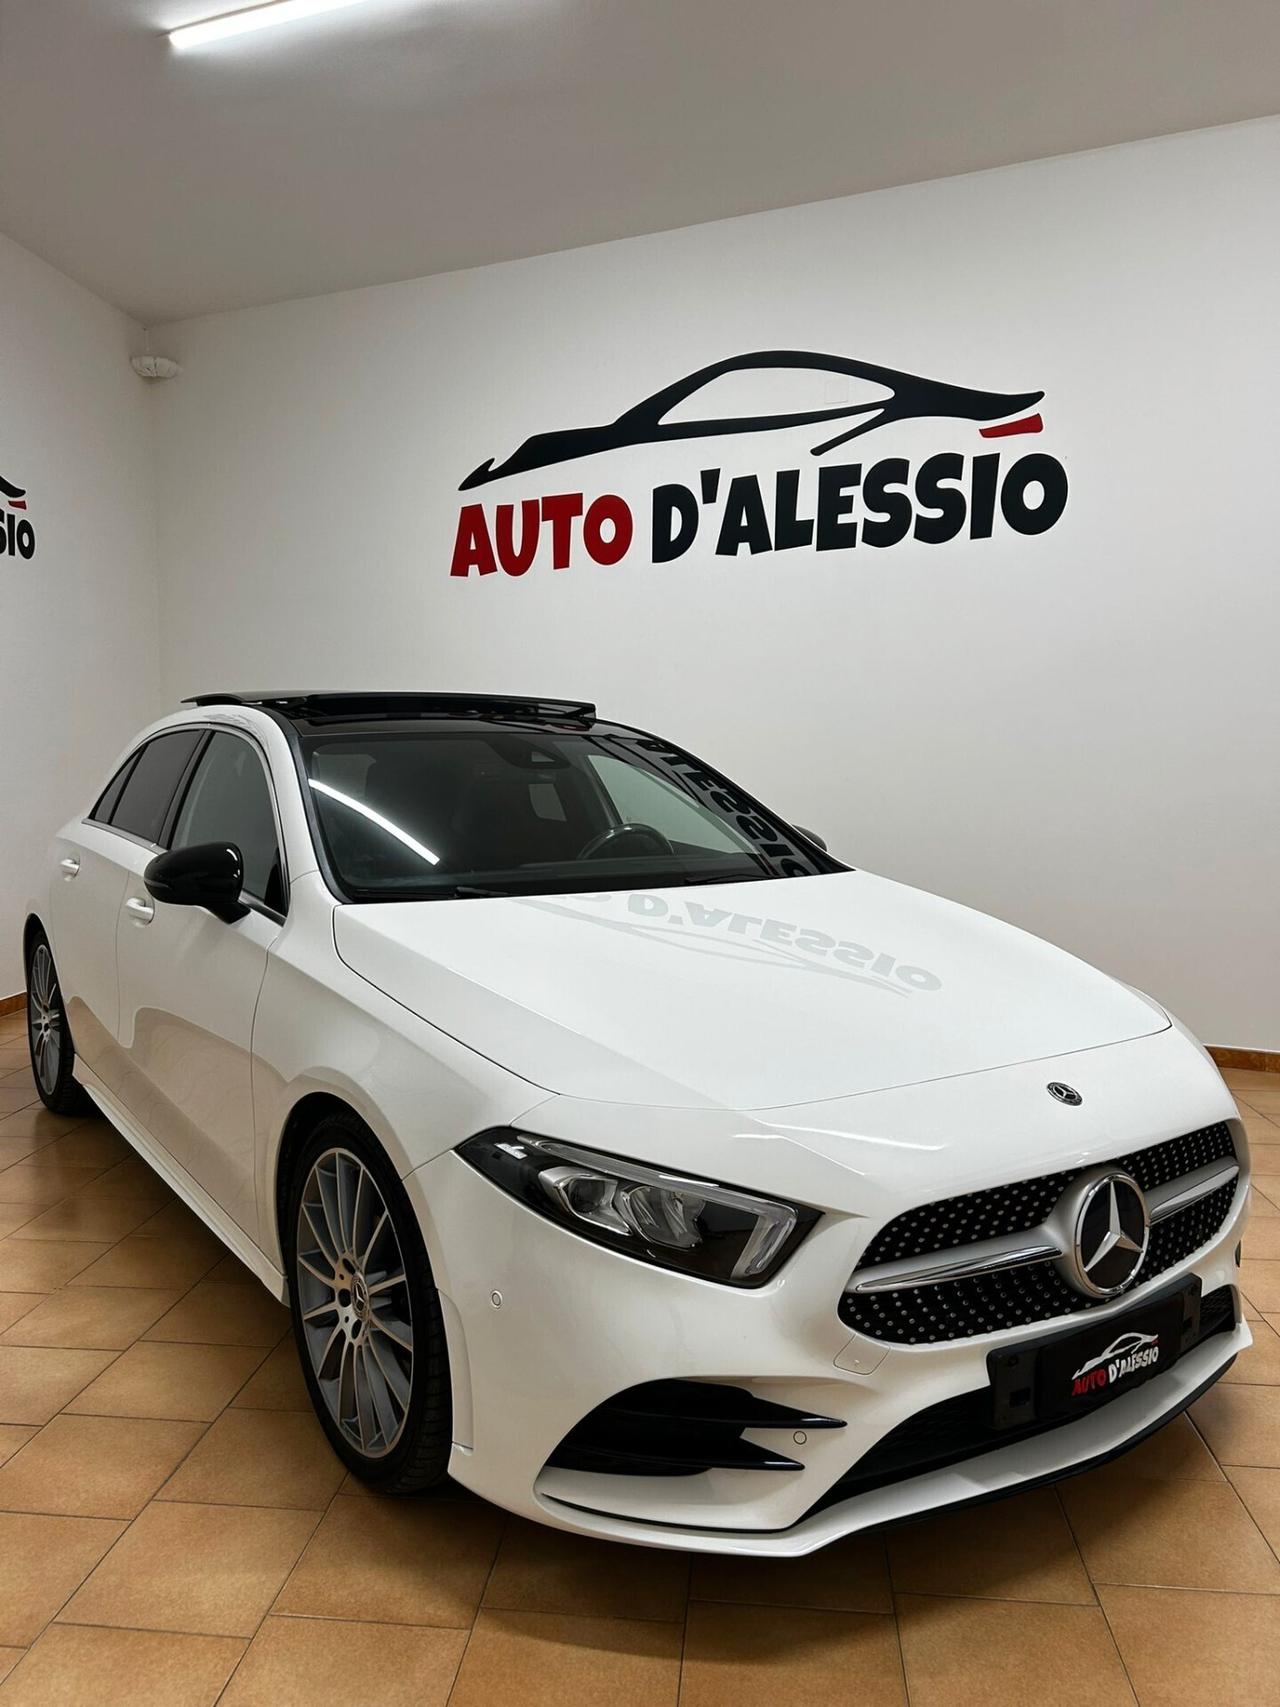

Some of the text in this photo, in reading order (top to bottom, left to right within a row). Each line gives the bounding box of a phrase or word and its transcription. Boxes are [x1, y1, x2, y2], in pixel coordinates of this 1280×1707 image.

[450, 452, 1068, 577] AUTO D'ALESSIO
[1072, 1346, 1159, 1396] AUTO D'ALESSIO
